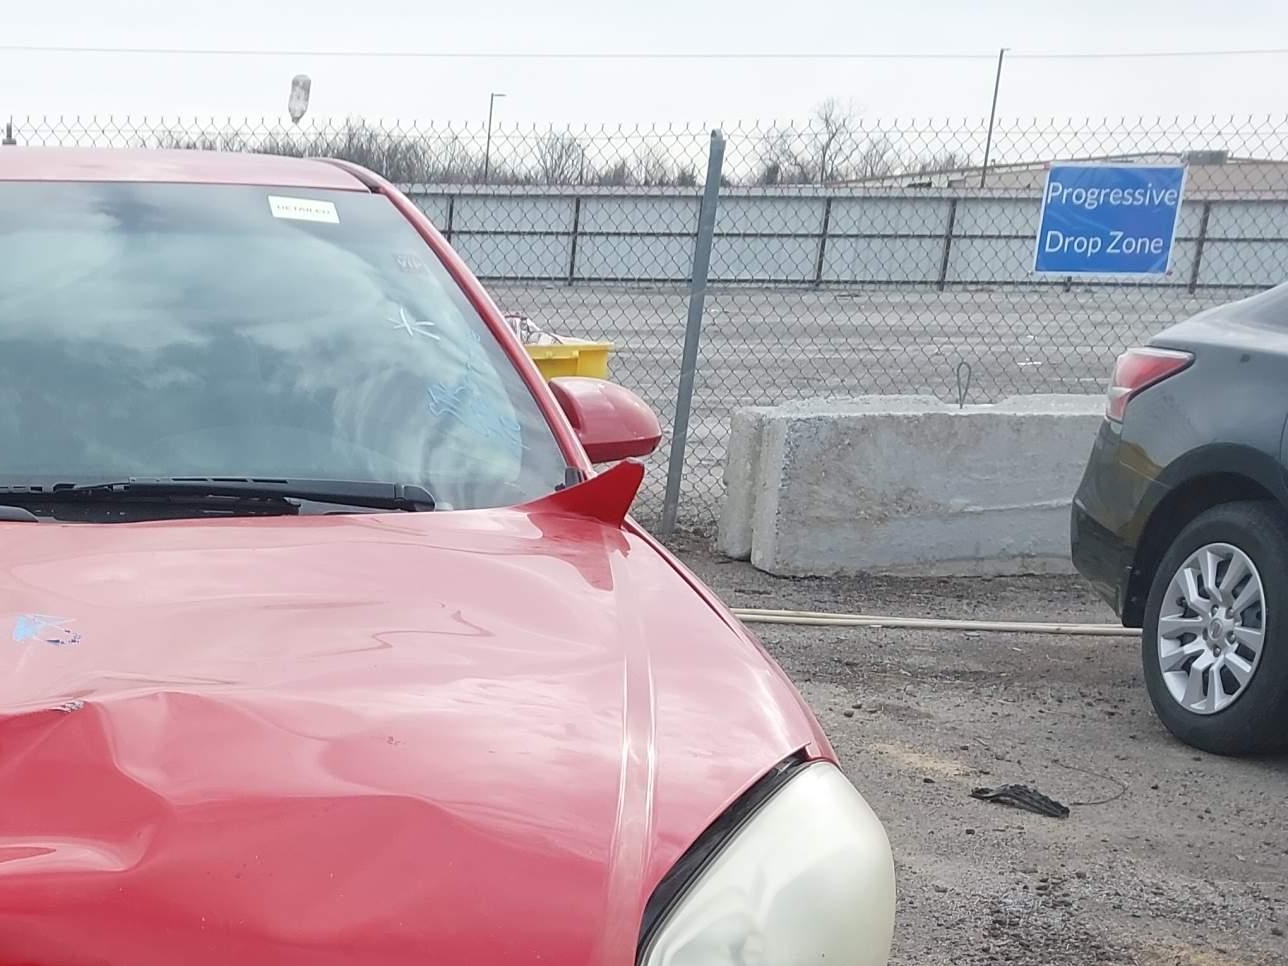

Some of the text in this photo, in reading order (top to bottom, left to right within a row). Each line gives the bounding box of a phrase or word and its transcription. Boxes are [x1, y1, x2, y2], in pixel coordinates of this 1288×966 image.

[1047, 181, 1178, 210] Progressive
[1045, 230, 1163, 257] Drop Zone
